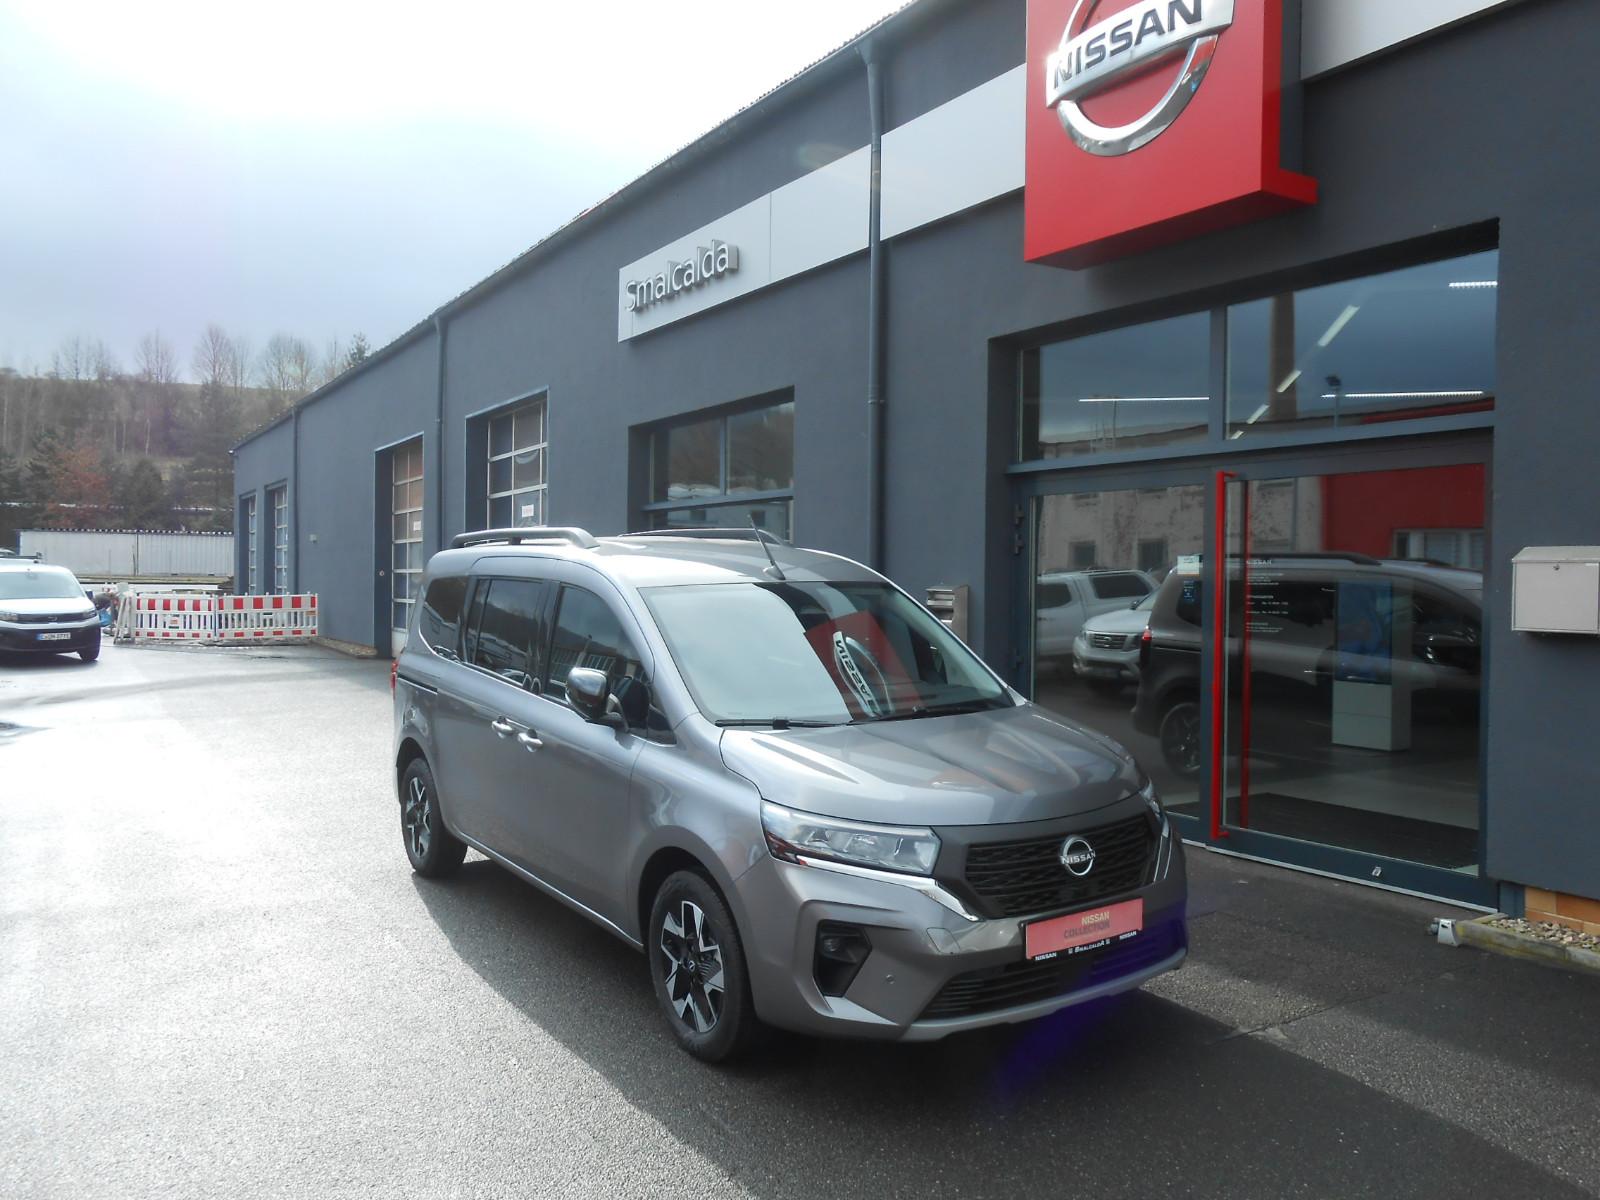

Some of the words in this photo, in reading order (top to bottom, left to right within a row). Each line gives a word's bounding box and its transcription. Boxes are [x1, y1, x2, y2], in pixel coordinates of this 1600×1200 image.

[1053, 0, 1202, 89] NISSAN
[625, 239, 738, 312] Smalcalda
[1060, 850, 1096, 864] NISSAN
[1081, 911, 1110, 926] NISSAN
[1063, 920, 1110, 939] COLLECTION
[1035, 952, 1057, 961] NISSAN
